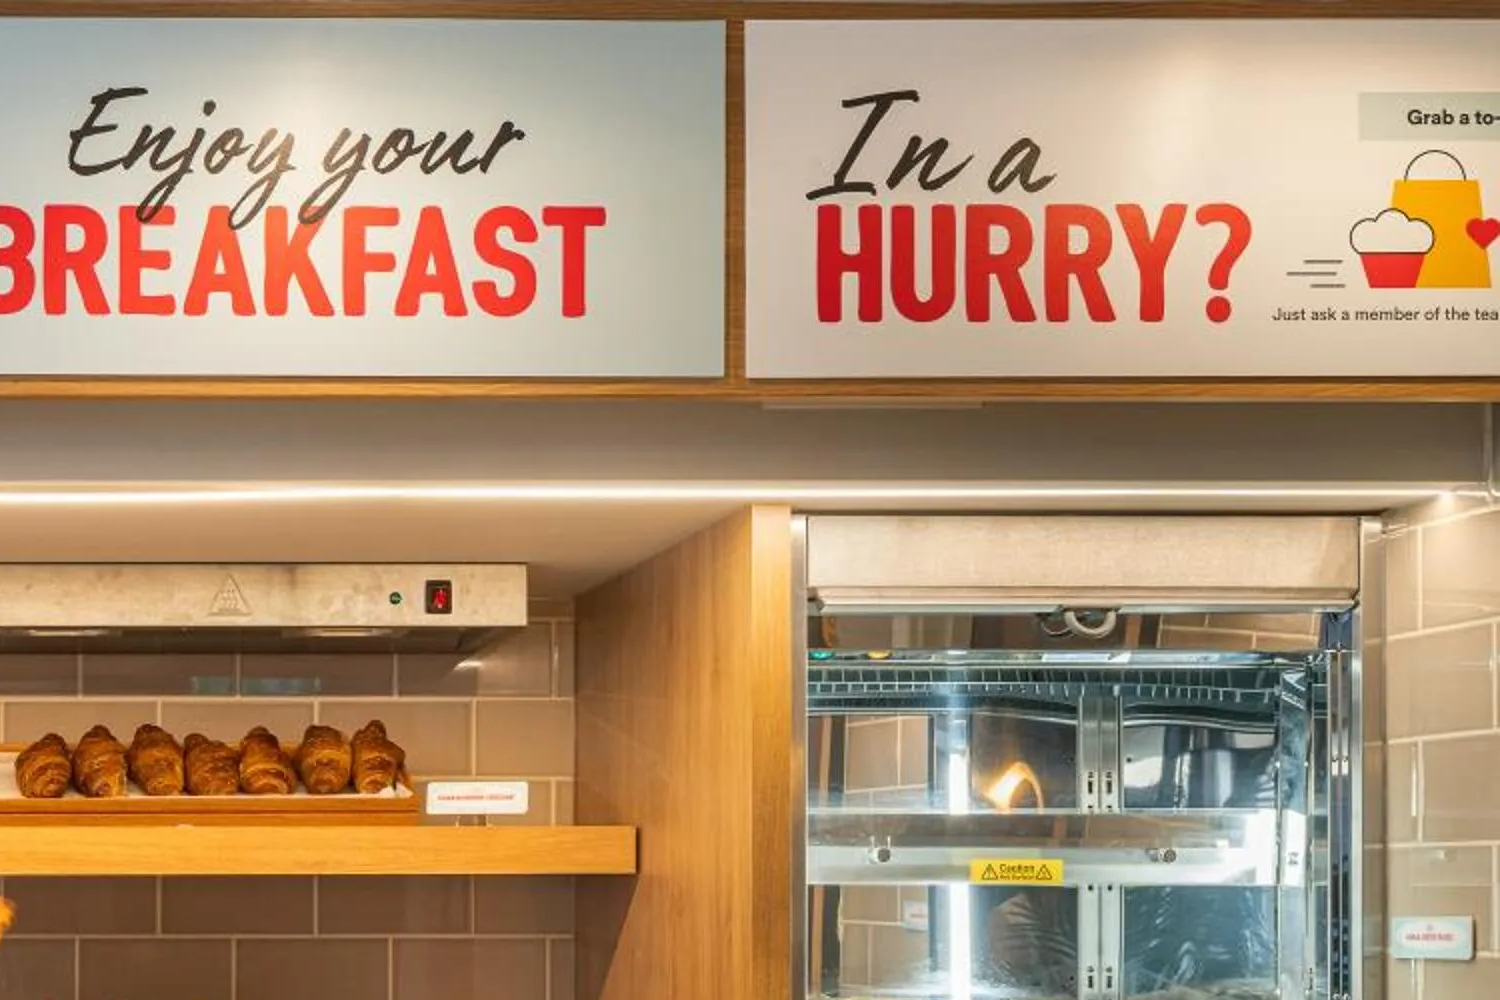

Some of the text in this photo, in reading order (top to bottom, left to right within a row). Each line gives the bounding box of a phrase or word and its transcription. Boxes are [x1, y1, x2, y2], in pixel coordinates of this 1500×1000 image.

[68, 86, 525, 230] Enjoy your
[806, 89, 1059, 201] In a
[1406, 108, 1455, 126] Grab
[1458, 112, 1471, 126] a
[816, 203, 1253, 324] HURRY?
[1271, 307, 1307, 321] Just
[1310, 307, 1337, 321] ask
[1340, 311, 1351, 321] a
[1355, 307, 1420, 321] member
[1423, 306, 1441, 321] of
[1445, 306, 1471, 321] the
